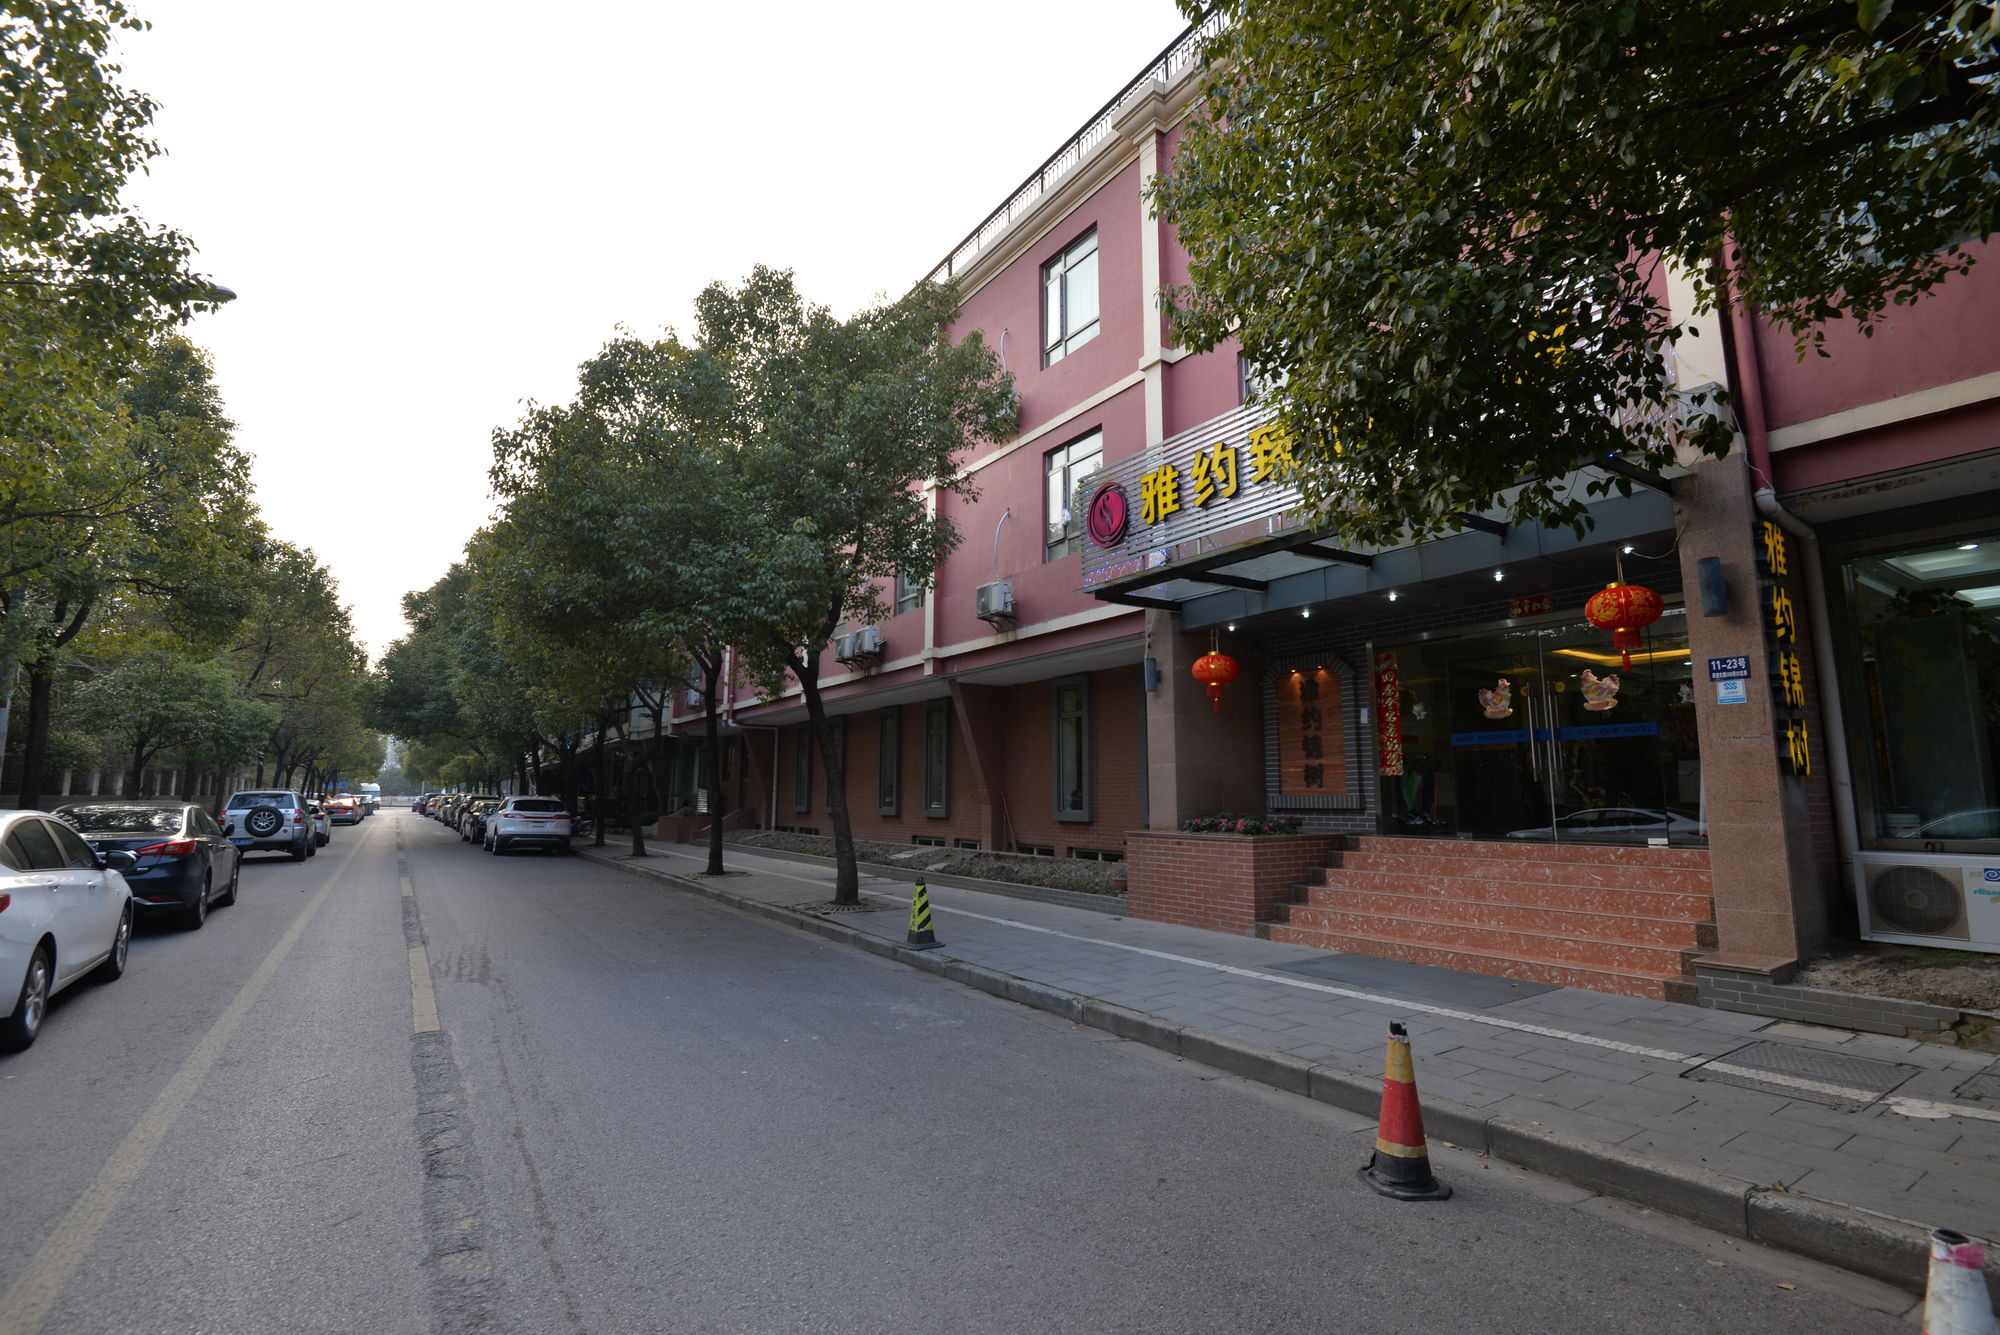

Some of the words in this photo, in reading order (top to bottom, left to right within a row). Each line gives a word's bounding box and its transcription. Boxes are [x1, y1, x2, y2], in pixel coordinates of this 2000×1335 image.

[1710, 657, 1747, 671] 11-23号
[1763, 520, 1811, 776] 雅约锦树
